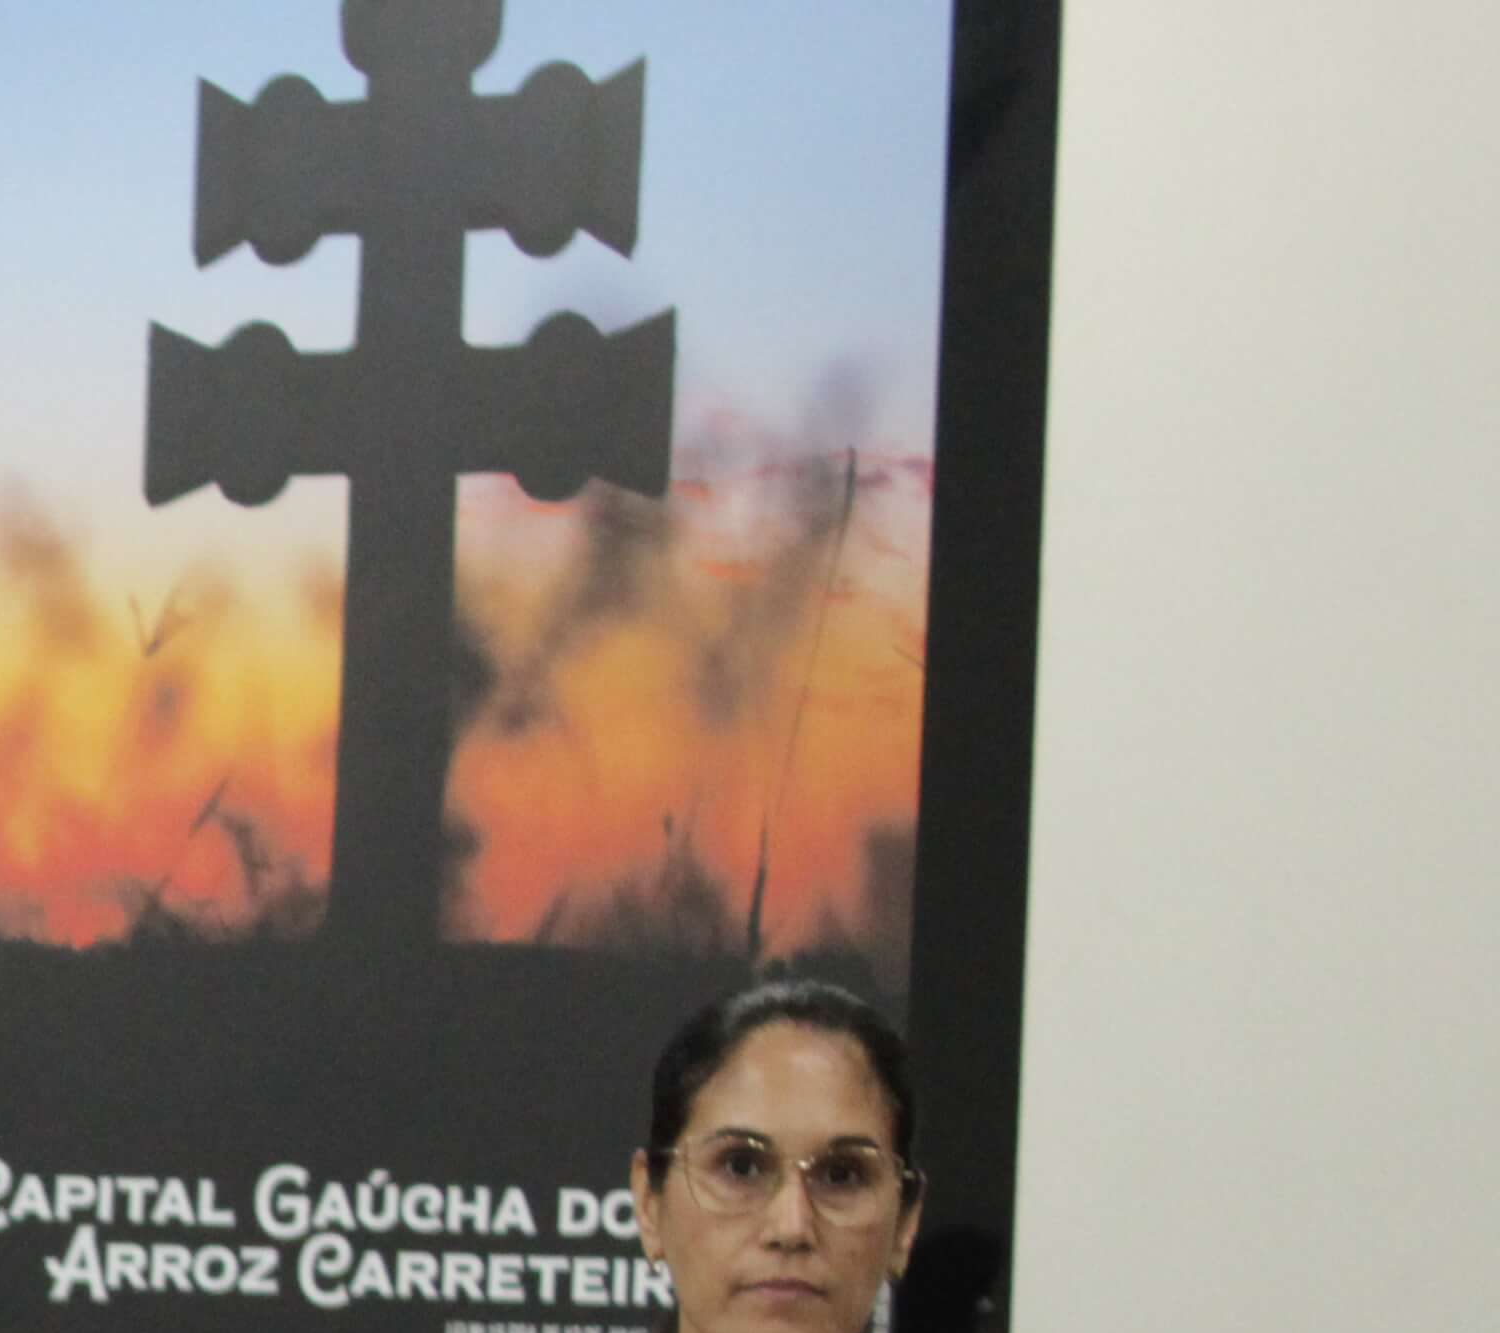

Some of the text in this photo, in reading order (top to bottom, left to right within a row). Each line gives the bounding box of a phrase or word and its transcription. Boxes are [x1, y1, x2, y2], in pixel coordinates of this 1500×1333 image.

[254, 1164, 537, 1241] GAÚCHA
[557, 1187, 638, 1239] DO
[44, 1224, 279, 1304] ARROZ
